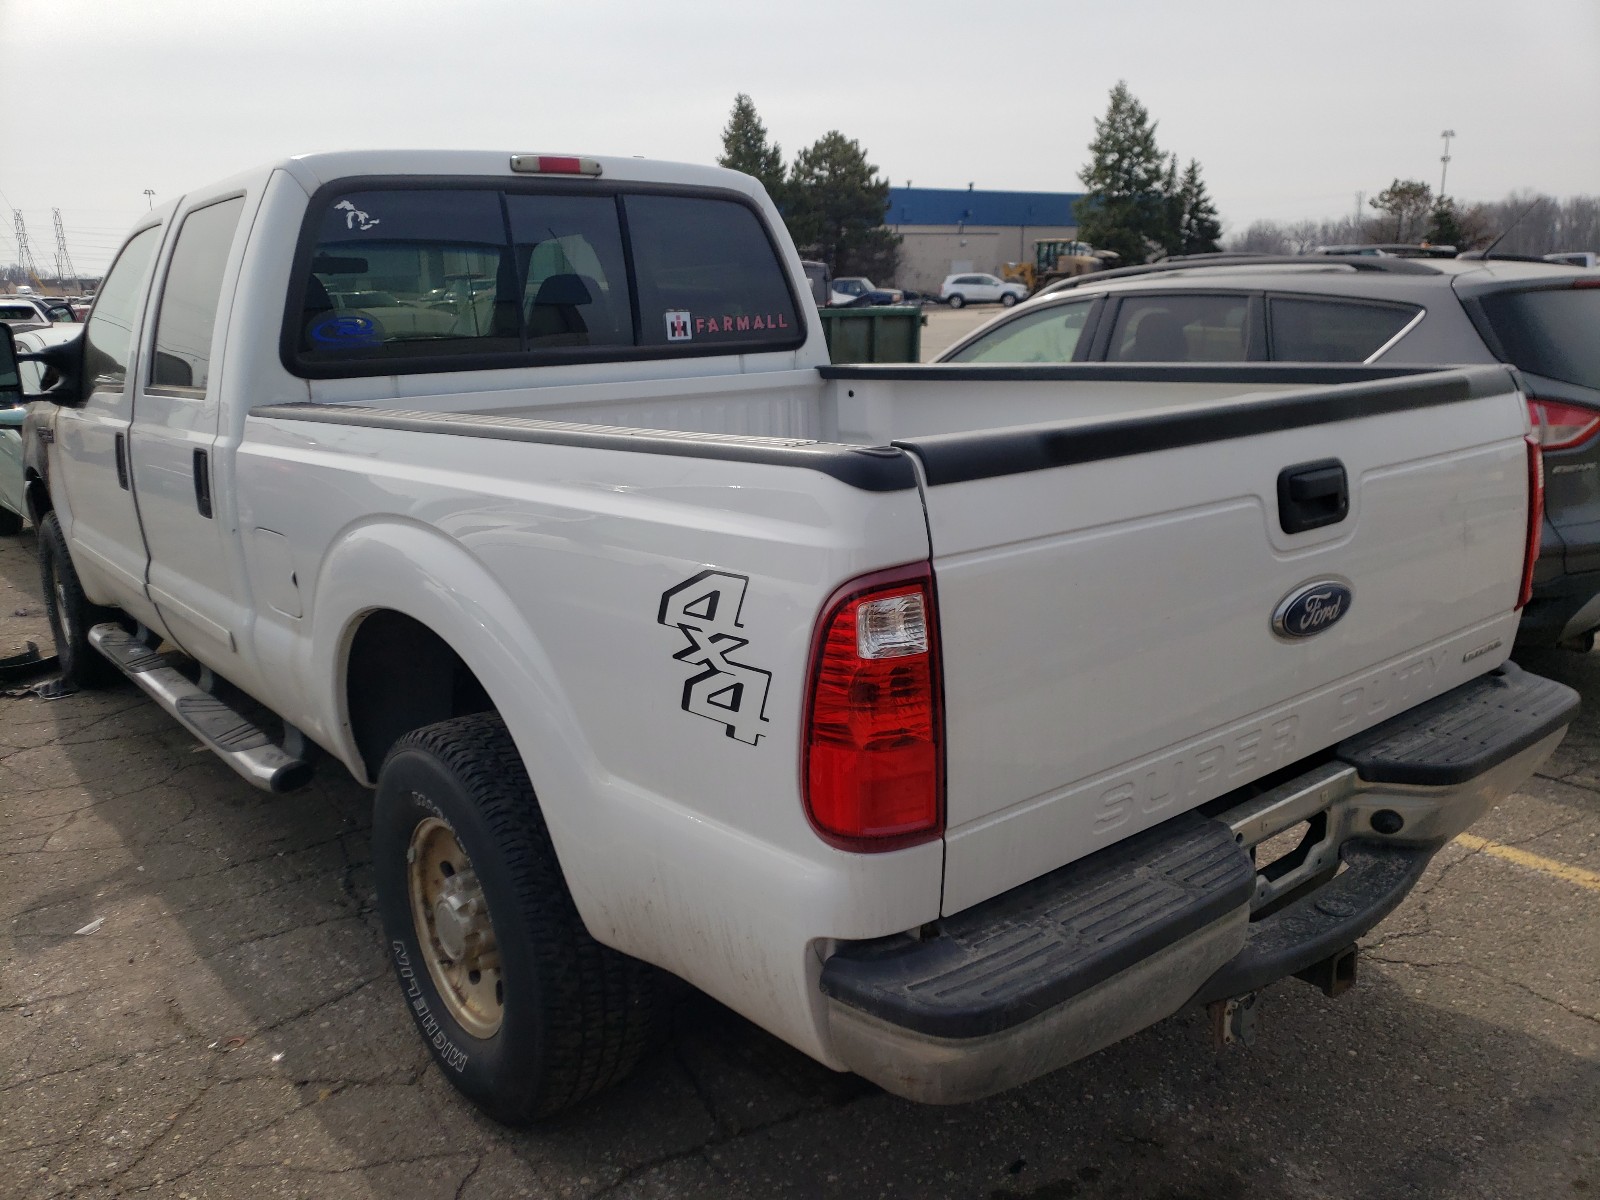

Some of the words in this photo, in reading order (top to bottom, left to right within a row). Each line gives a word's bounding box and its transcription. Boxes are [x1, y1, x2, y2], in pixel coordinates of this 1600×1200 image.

[695, 313, 788, 334] FARMALL
[1299, 591, 1342, 631] Ford
[1093, 712, 1302, 836] SUPER
[1331, 648, 1451, 733] DUTY
[392, 940, 469, 1073] MICHELIN
